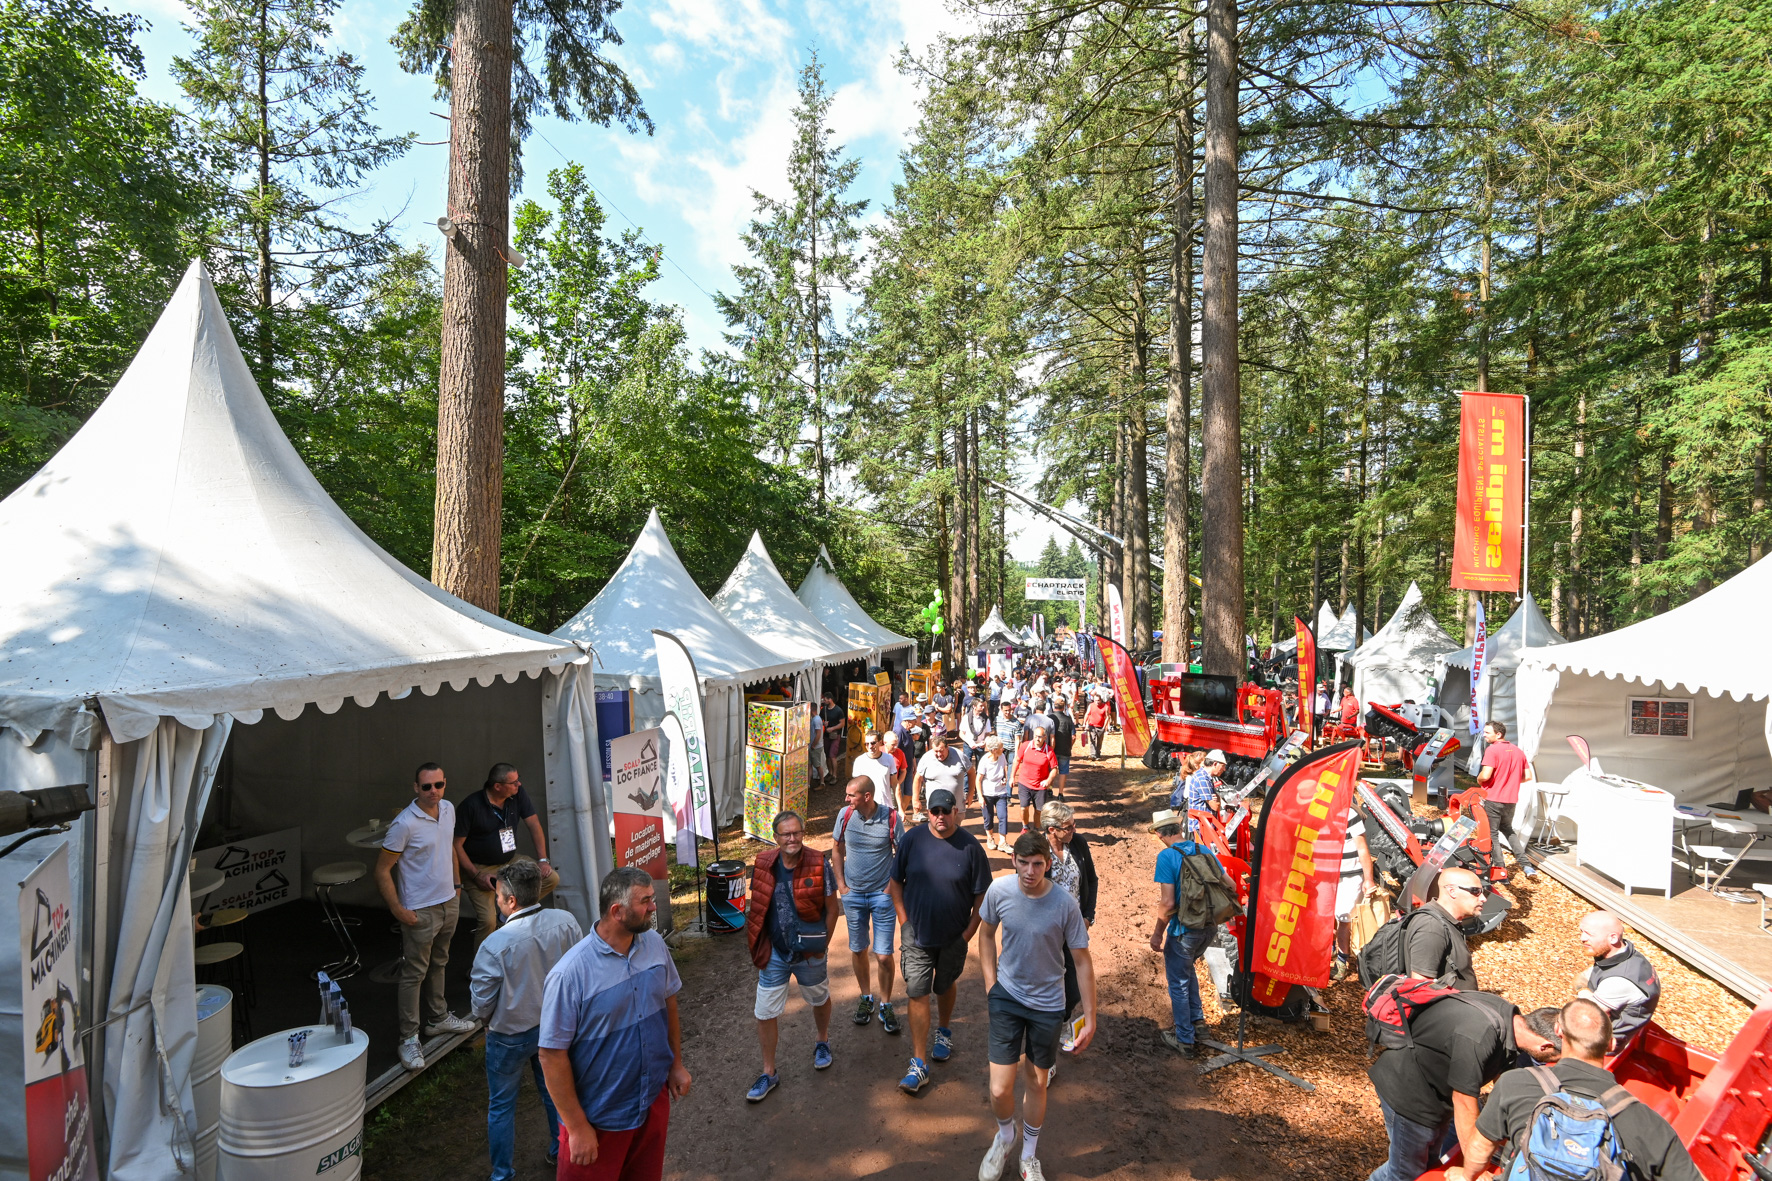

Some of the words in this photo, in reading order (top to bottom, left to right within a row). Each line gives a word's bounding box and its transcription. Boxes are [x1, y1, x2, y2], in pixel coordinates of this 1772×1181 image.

[617, 771, 633, 785] LOC
[633, 761, 658, 779] FRANCE
[630, 822, 655, 843] Location
[251, 848, 275, 862] TOP
[624, 846, 634, 860] de
[221, 890, 254, 906] SCALP
[1266, 824, 1320, 967] seppi
[51, 903, 65, 934] TOP
[31, 920, 72, 991] MACHINERY
[321, 1151, 340, 1171] SN
